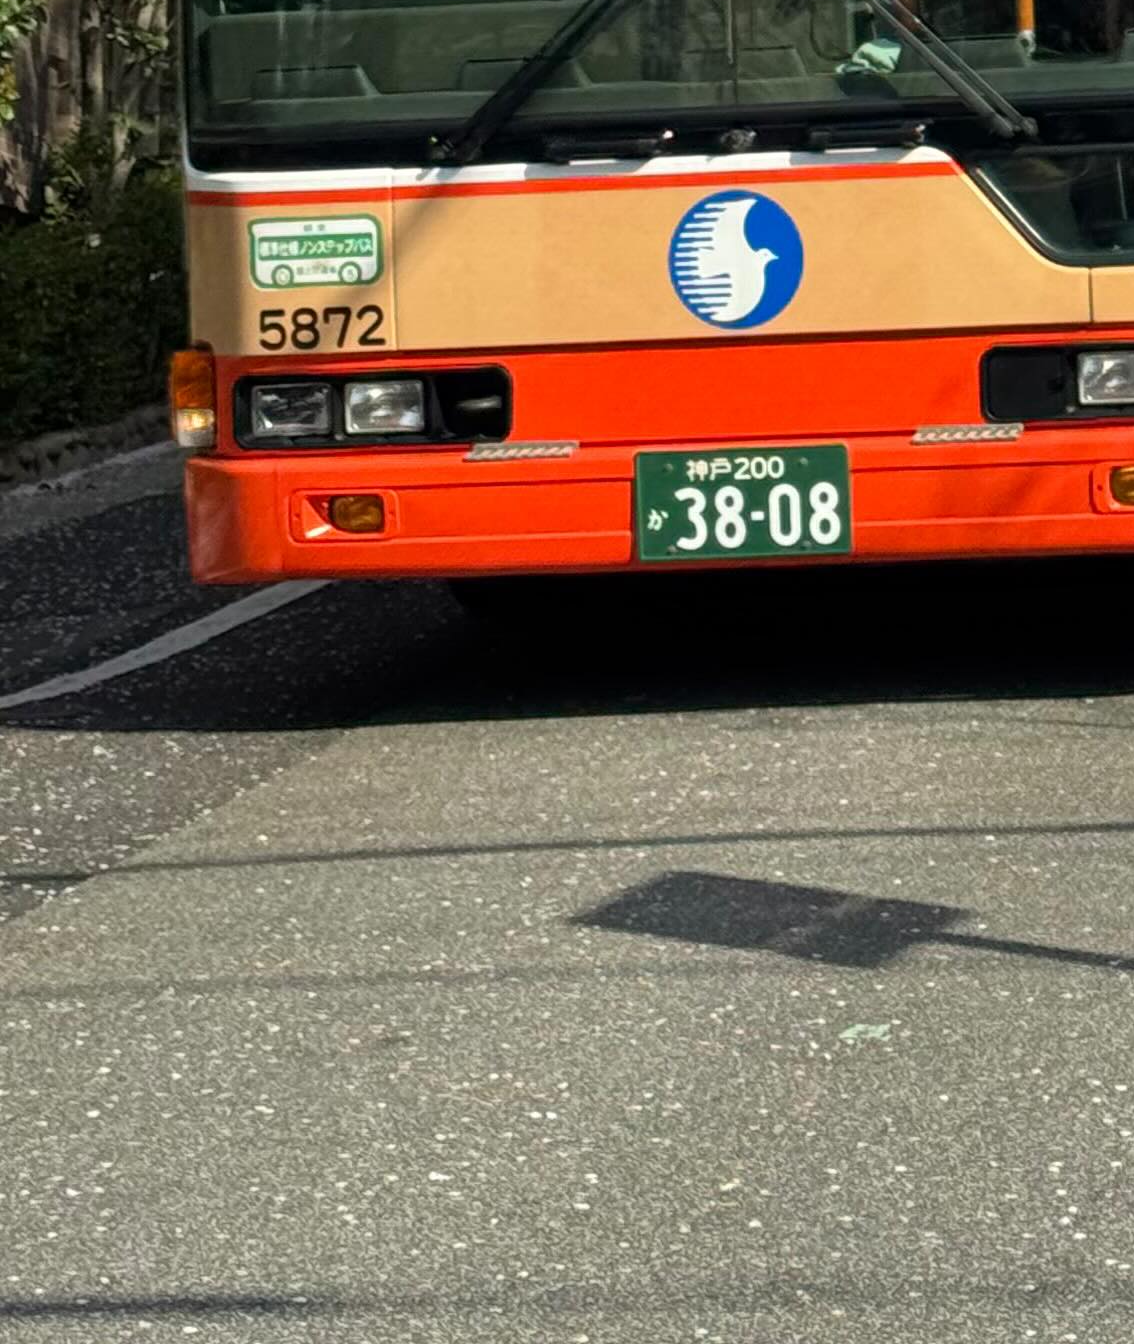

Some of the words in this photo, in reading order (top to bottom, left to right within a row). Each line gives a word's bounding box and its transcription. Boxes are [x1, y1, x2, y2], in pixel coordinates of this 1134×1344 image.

[260, 304, 386, 351] 5872
[686, 455, 785, 481] 神戸200
[647, 508, 669, 531] か
[674, 481, 841, 550] 38-08
